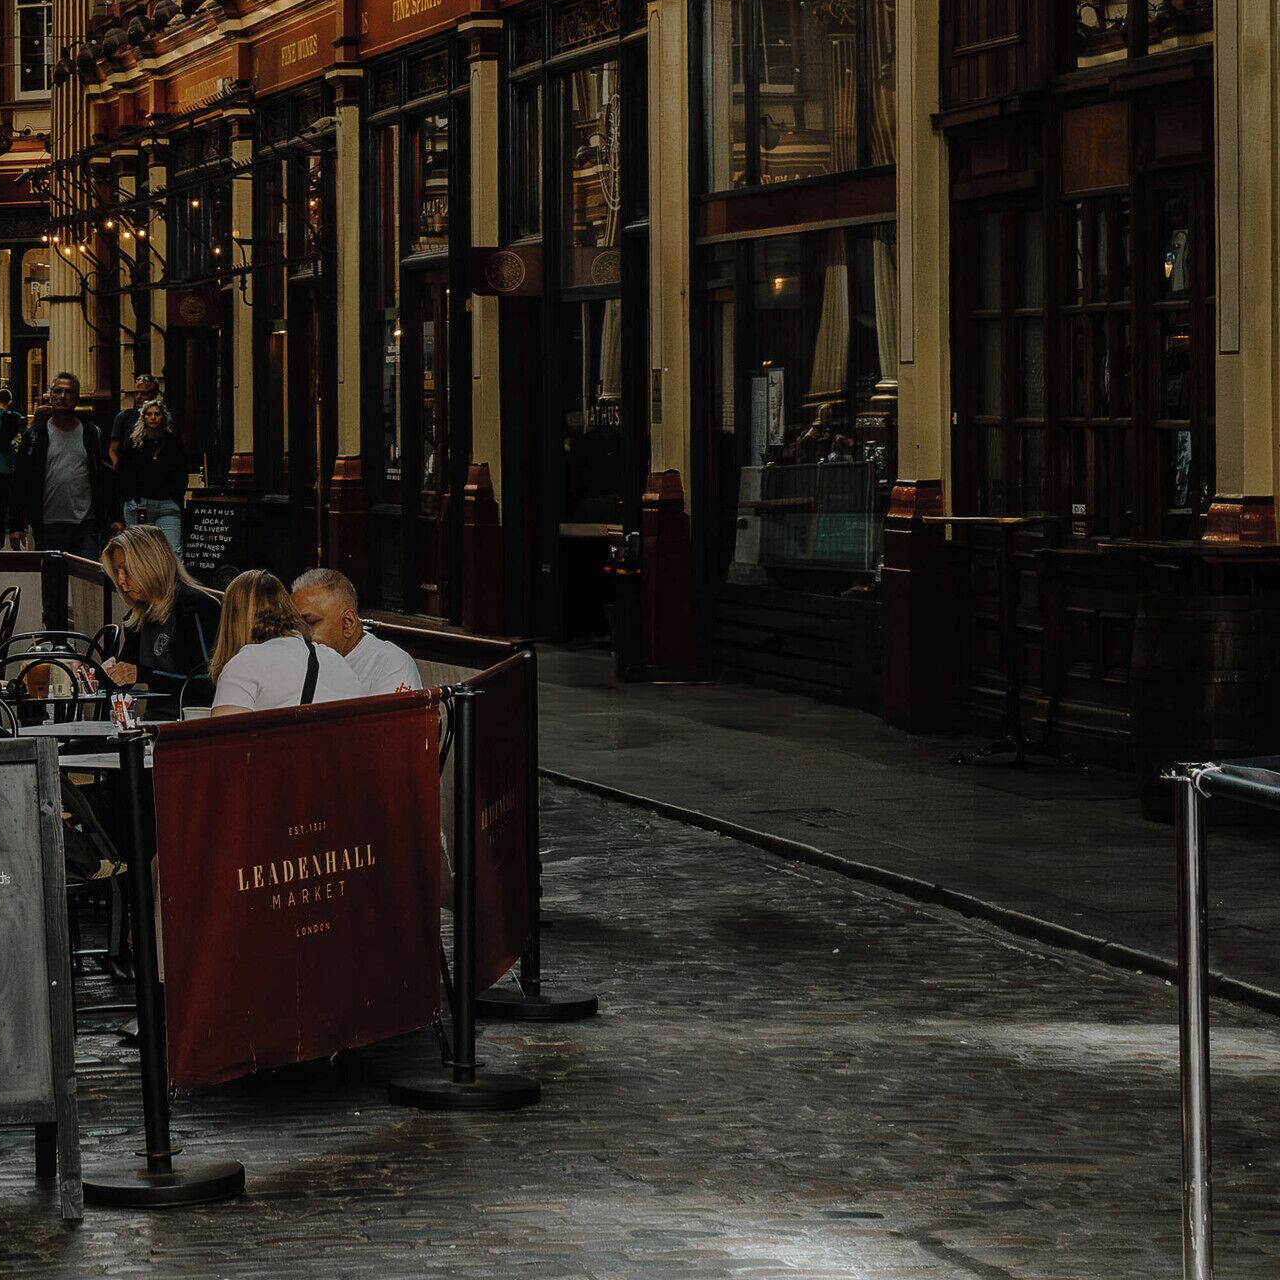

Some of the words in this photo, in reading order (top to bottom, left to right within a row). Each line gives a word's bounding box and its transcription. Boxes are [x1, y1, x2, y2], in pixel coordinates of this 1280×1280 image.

[194, 508, 235, 516] AMATHUS
[194, 524, 230, 533] DELIVERY
[237, 844, 376, 892] LEADENHALL
[271, 880, 346, 910] MARKET
[296, 922, 331, 937] LONDON
